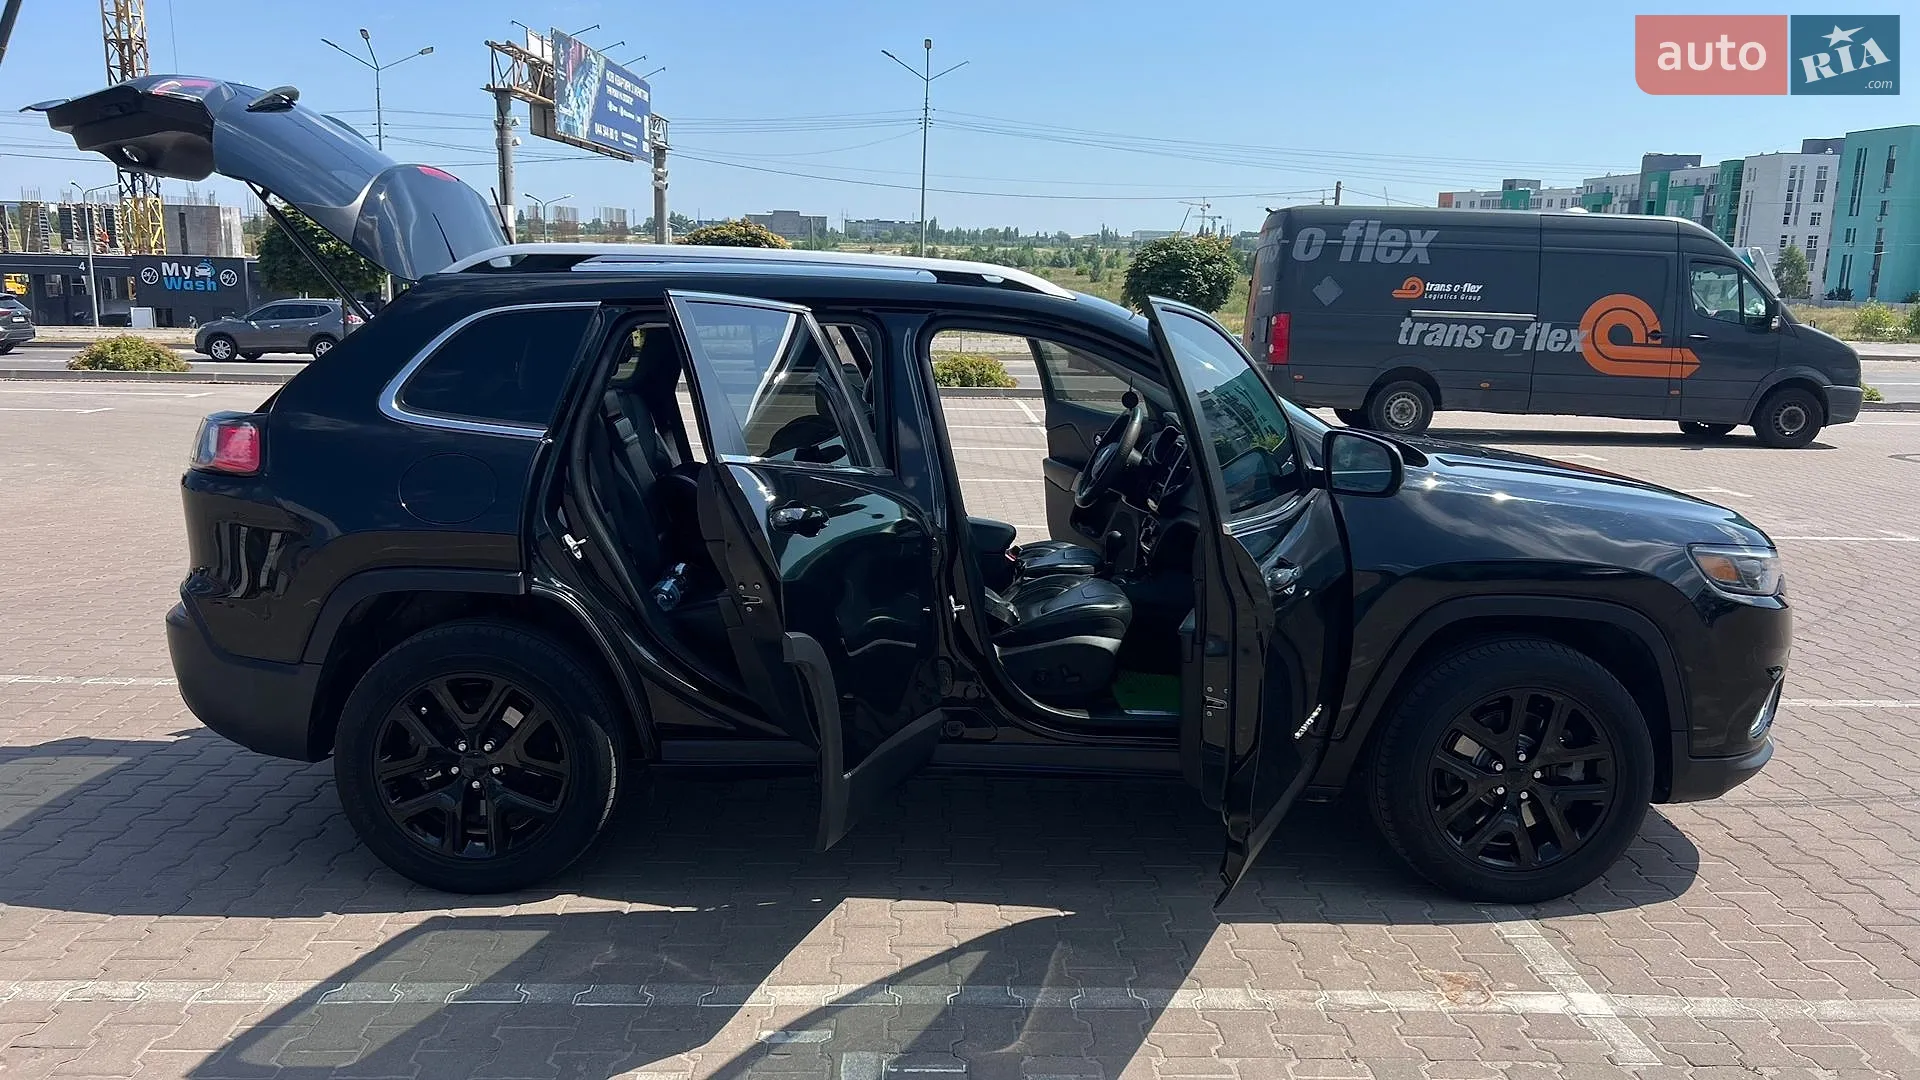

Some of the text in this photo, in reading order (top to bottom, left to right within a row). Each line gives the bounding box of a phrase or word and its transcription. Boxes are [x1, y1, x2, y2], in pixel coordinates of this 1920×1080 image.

[78, 261, 86, 271] 4
[161, 262, 192, 280] My
[143, 269, 156, 282] 24/7
[222, 271, 235, 284] 24/7
[163, 276, 217, 291] Wash
[1424, 292, 1482, 301] Logistics Group
[1397, 317, 1589, 353] trans-o-flex
